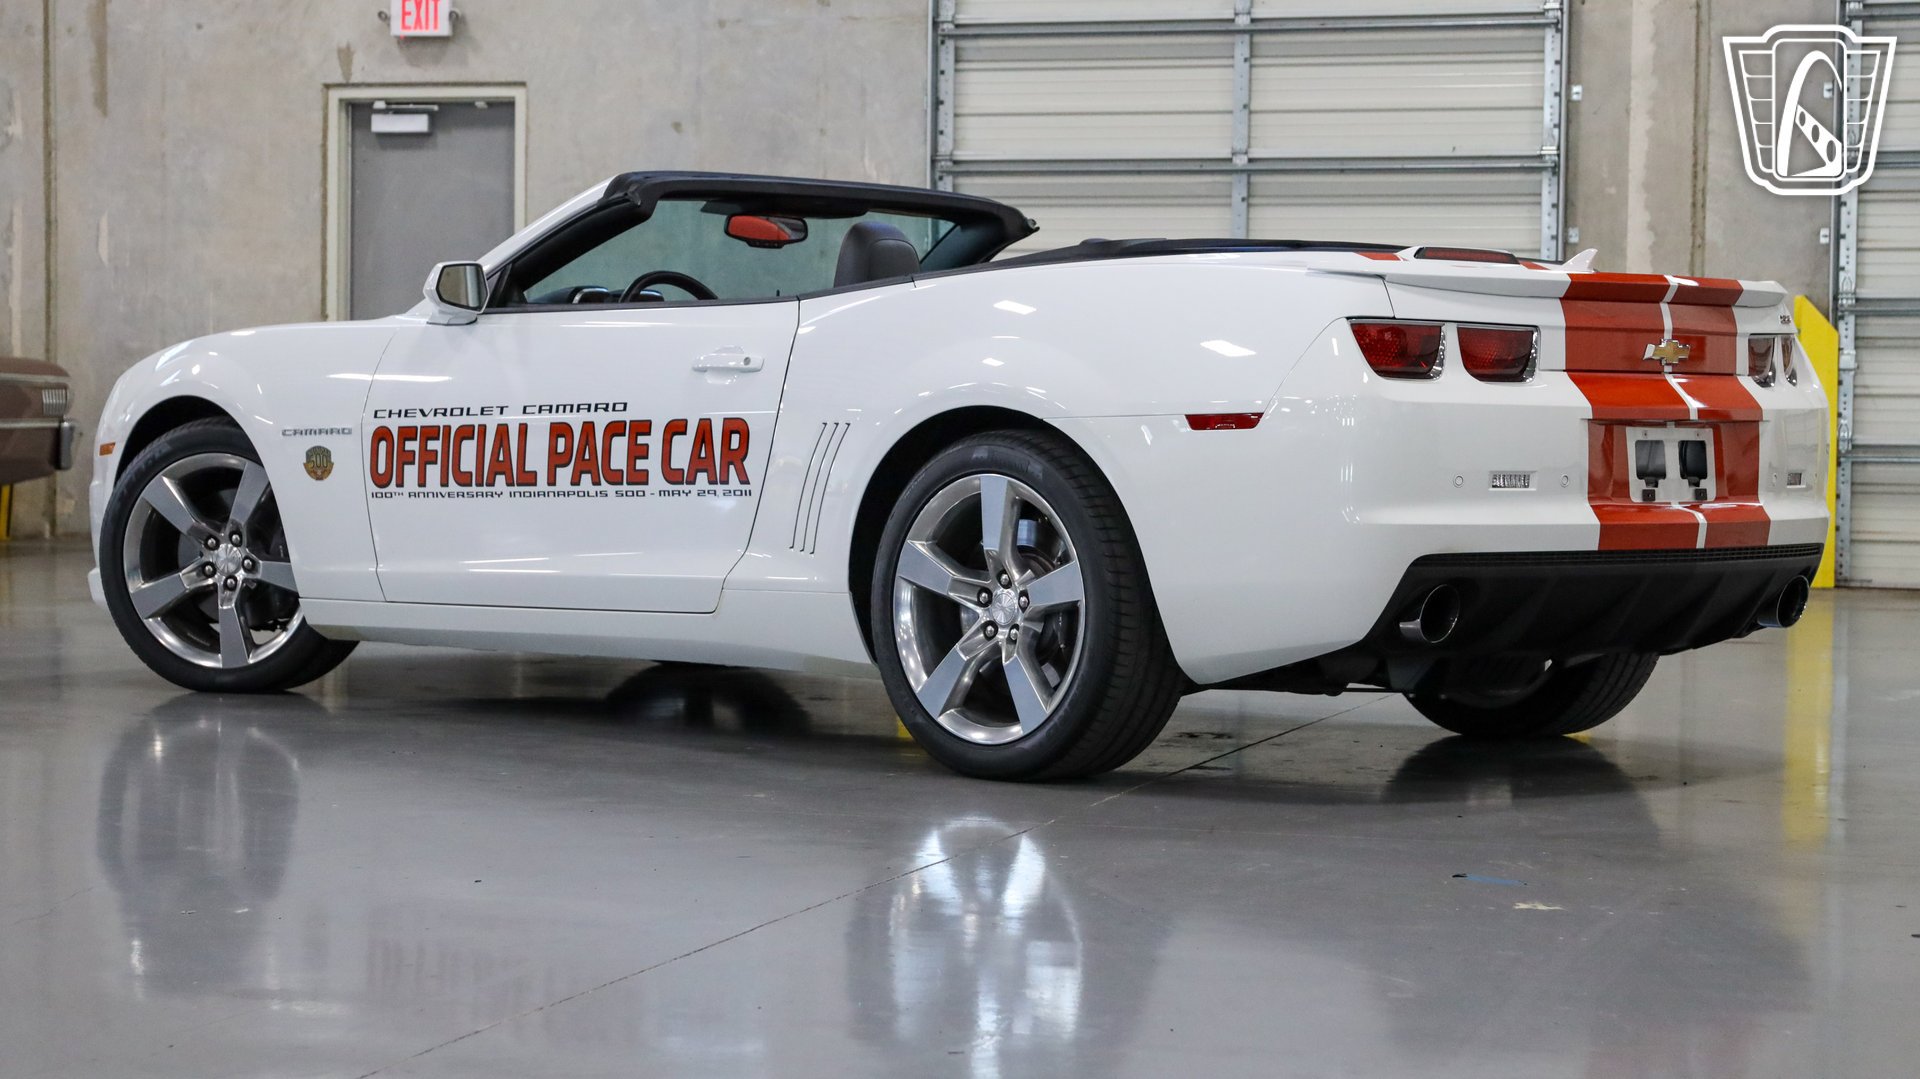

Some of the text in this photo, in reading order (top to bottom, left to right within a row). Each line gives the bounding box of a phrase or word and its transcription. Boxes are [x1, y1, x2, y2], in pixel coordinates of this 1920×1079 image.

[401, 0, 440, 31] EXIT
[374, 402, 627, 418] CHEVROLET CAMARO
[282, 427, 352, 437] CAMARO
[370, 417, 750, 489] OFFICIAL PACE CAR
[408, 491, 503, 499] ANNIVERSARY
[509, 490, 608, 498] INDIANAPOLIS
[659, 489, 691, 497] MAY
[723, 489, 752, 497] 2011
